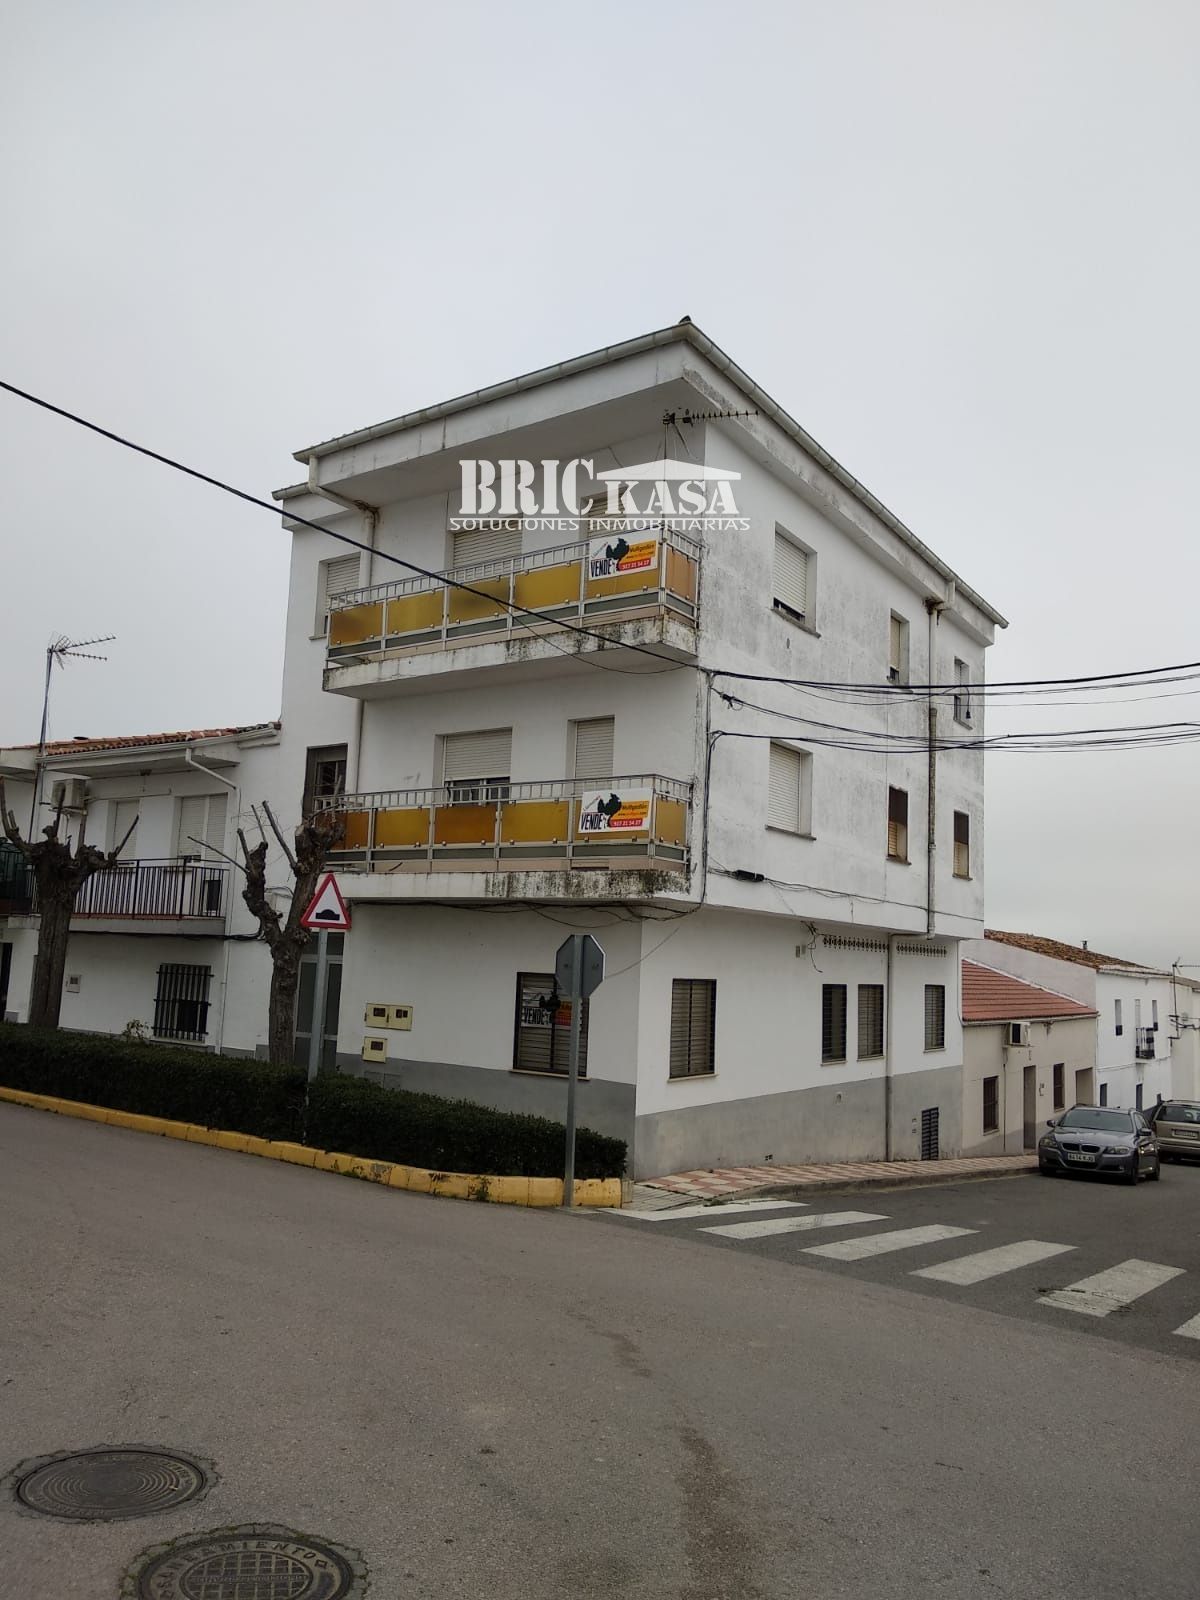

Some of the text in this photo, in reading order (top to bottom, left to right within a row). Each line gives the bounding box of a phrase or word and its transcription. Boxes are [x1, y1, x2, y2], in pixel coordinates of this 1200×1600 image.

[591, 559, 611, 577] VENDE
[581, 813, 603, 830] VENDE
[524, 1007, 545, 1025] VENDE
